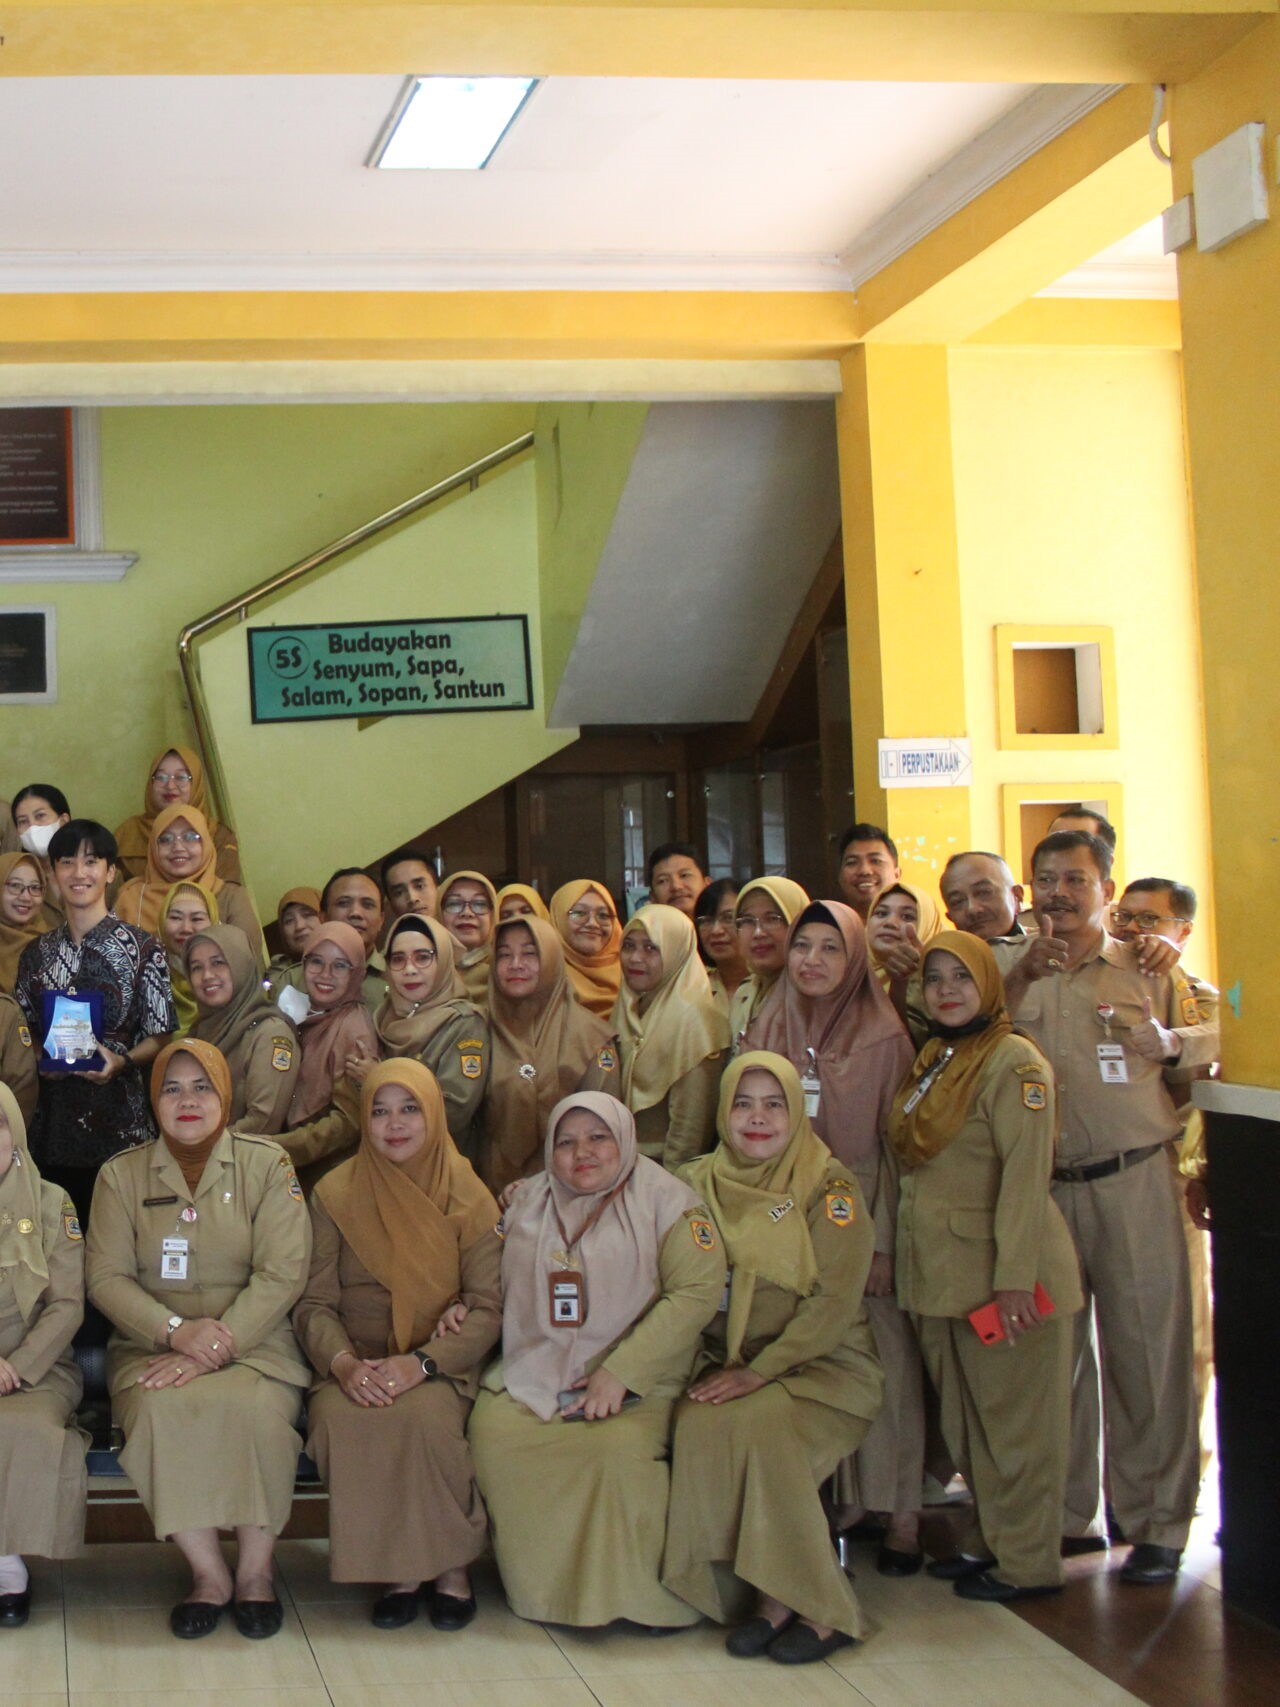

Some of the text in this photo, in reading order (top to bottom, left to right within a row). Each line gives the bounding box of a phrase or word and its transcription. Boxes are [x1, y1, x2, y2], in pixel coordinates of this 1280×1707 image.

[328, 630, 451, 656] Budayakan
[276, 646, 302, 669] 5S
[314, 655, 464, 683] Senyum, Sapa,
[281, 679, 506, 708] Salam, Sopan, Santun
[901, 752, 960, 774] PERPUSTAKAAN
